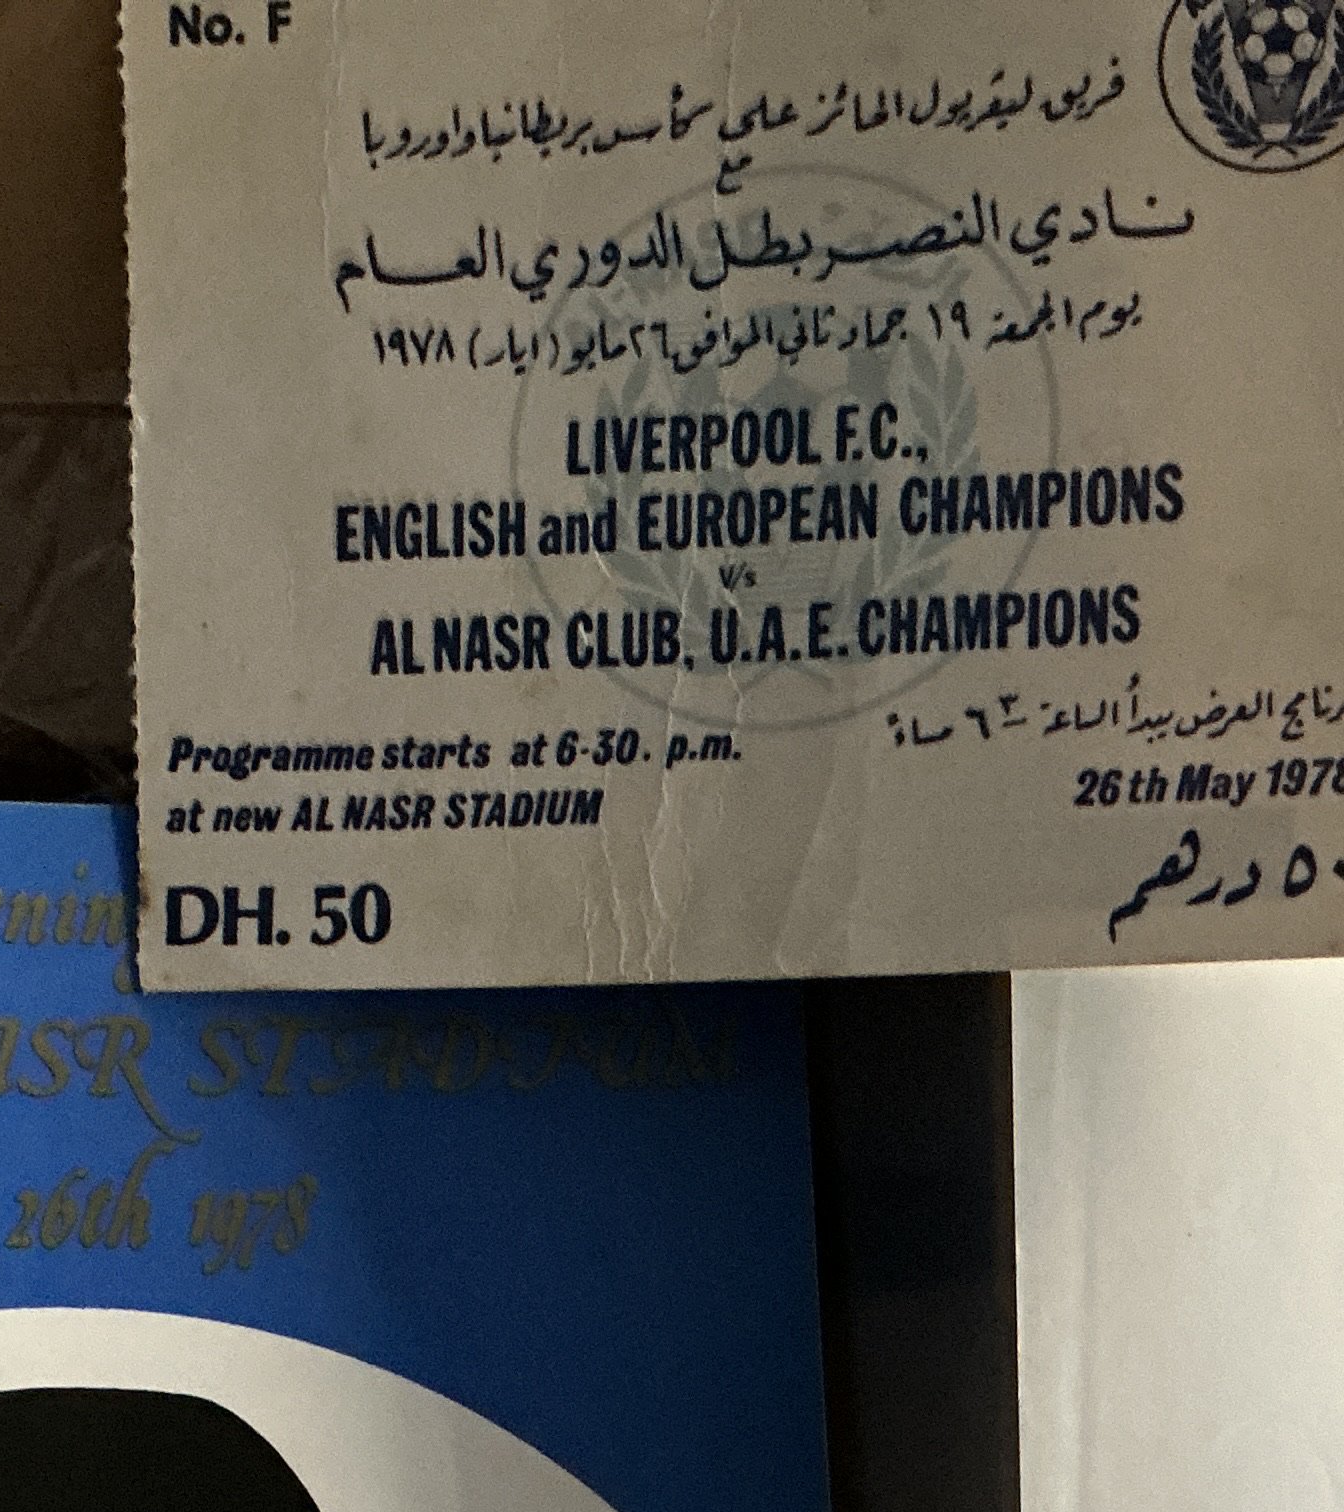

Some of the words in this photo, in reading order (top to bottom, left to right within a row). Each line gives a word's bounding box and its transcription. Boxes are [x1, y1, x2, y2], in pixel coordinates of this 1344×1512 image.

[169, 3, 245, 46] No.
[267, 1, 292, 43] F
[1039, 56, 1125, 122] فريق
[511, 210, 683, 301] الدوري
[690, 206, 812, 290] بطل
[815, 187, 1001, 282] النصر
[1010, 187, 1195, 267] نادي
[335, 224, 504, 314] العام
[374, 325, 456, 367] ١٩٧٨
[1079, 290, 1142, 343] يوم
[565, 406, 821, 476] LIVERPOOL
[335, 499, 526, 562] ENGLISH
[539, 497, 617, 556] and
[638, 481, 878, 552] EUROPEAN
[900, 463, 1184, 537] CHAMPIONS
[371, 619, 426, 676] AL
[432, 612, 552, 674] NASR
[567, 607, 695, 672] CLUB,
[709, 601, 850, 666] U.A.E.
[858, 584, 1140, 659] CHAMPIONS
[167, 735, 374, 781] Programme
[382, 733, 490, 770] starts
[511, 735, 547, 768] at
[666, 731, 743, 770] p.m.
[1175, 763, 1256, 808] May
[165, 799, 205, 834] at
[212, 803, 283, 833] new
[291, 796, 334, 832] AL
[342, 792, 435, 831] NASR
[444, 789, 605, 829] STADIUM
[164, 886, 291, 946] DH.
[310, 881, 391, 946] 50
[1109, 827, 1260, 943] درهم
[4, 1140, 176, 1251] 26th
